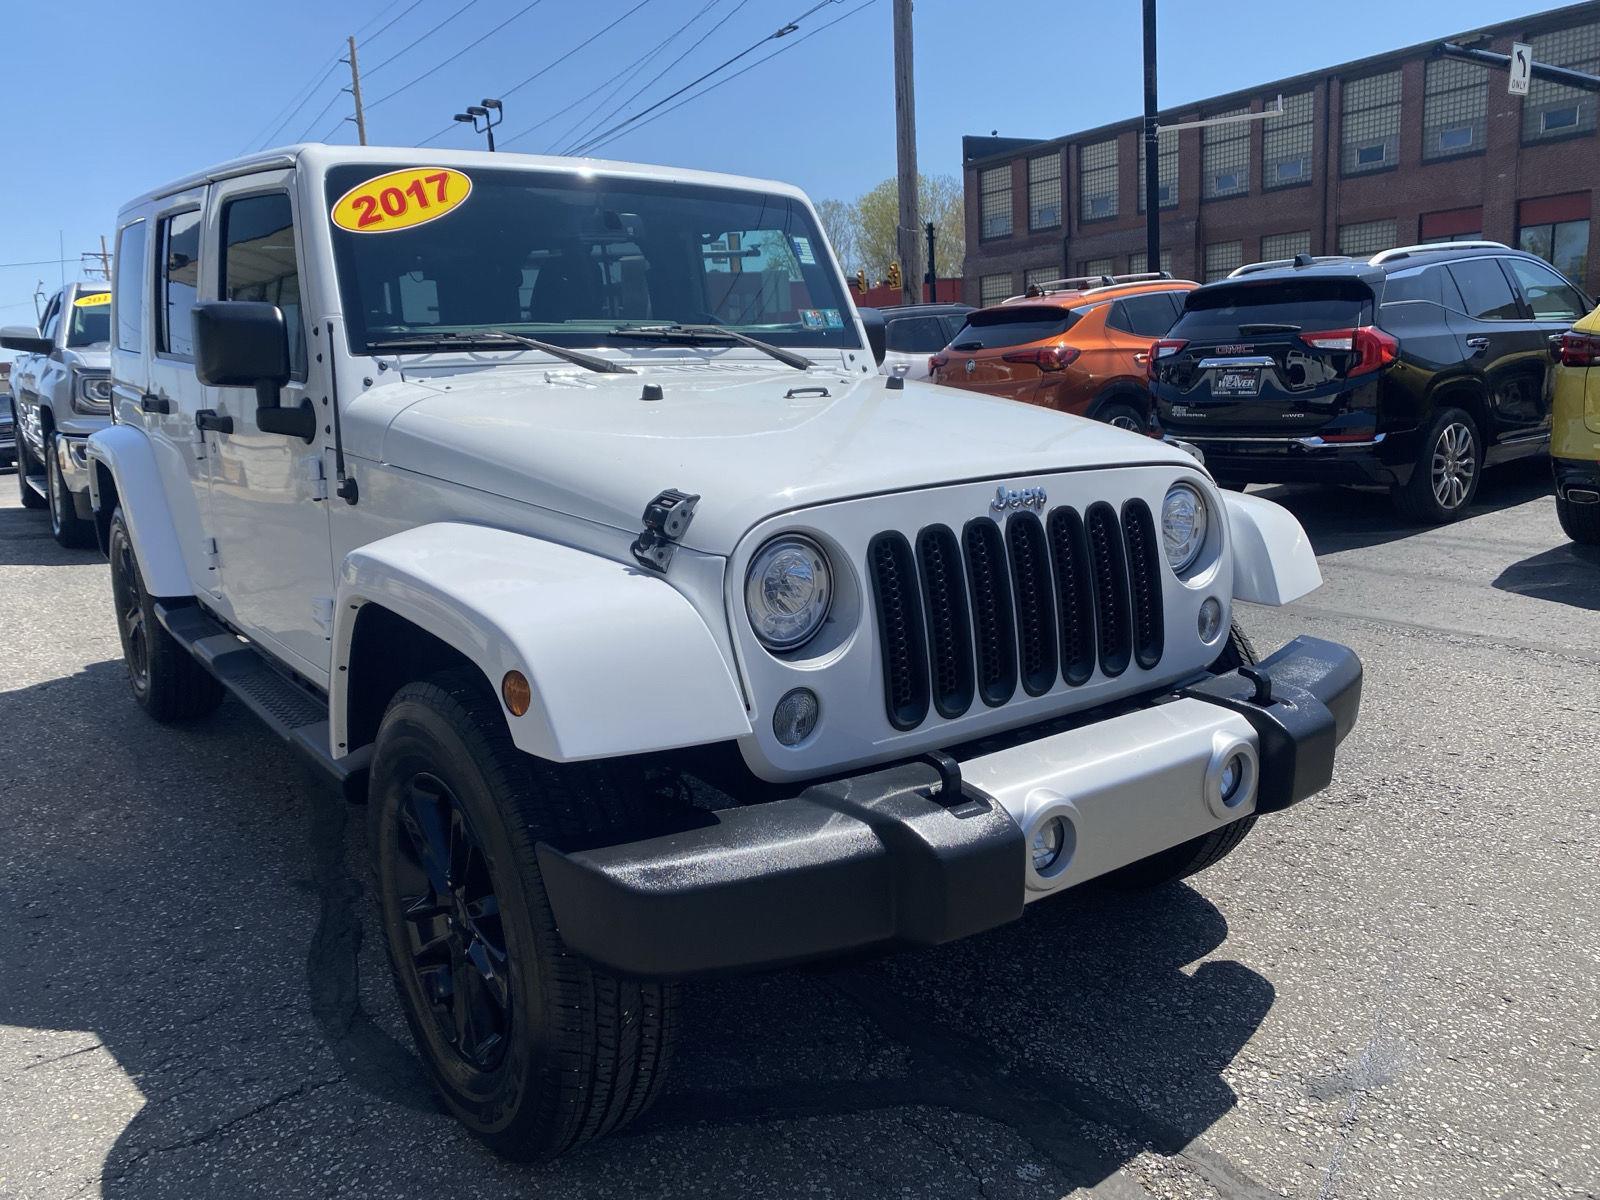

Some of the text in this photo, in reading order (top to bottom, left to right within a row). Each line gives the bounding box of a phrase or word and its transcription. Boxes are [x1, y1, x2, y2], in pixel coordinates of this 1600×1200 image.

[1511, 79, 1527, 89] ONLY
[352, 171, 449, 230] 2017
[85, 294, 109, 305] 201
[1216, 343, 1255, 354] GMC
[1218, 380, 1255, 388] WEAVER
[990, 485, 1048, 512] Jeep
